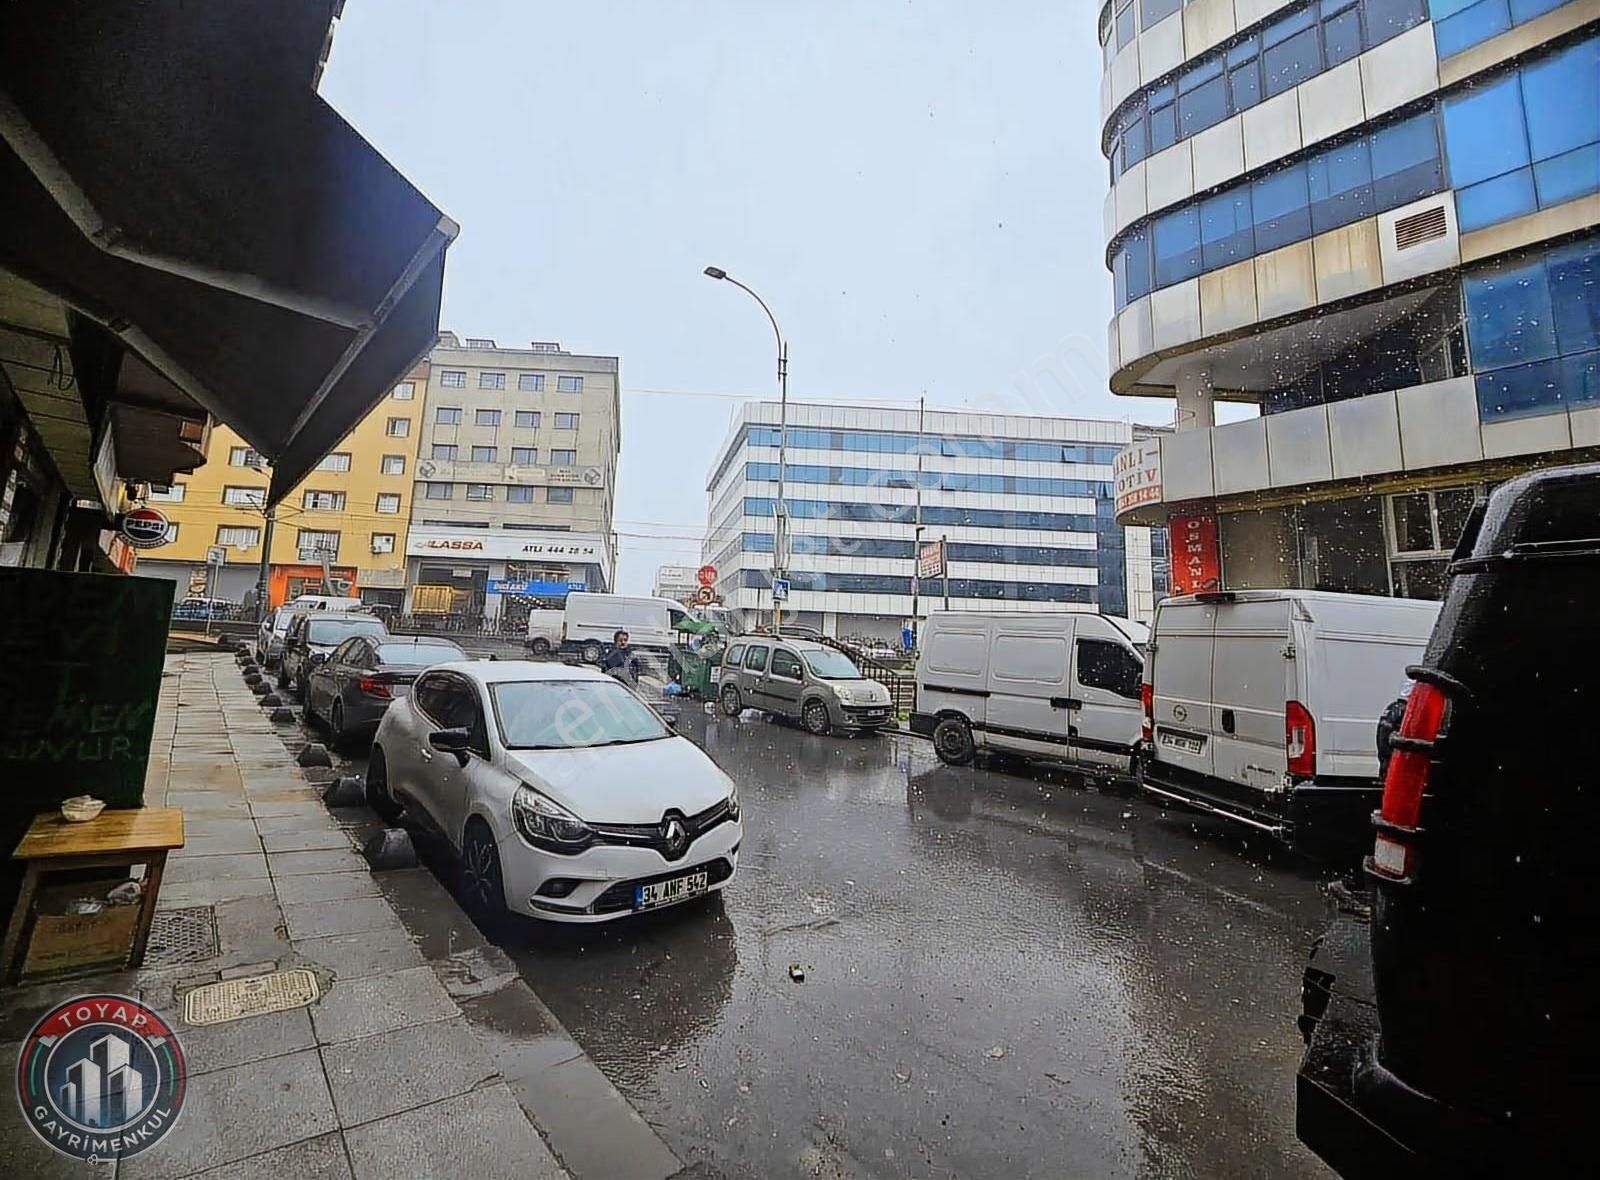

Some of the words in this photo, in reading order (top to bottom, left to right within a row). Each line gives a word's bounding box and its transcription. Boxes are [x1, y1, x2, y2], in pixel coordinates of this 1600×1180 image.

[126, 519, 165, 531] PEPSI
[430, 540, 484, 551] LASSA
[643, 886, 658, 903] 34
[686, 874, 706, 891] 542
